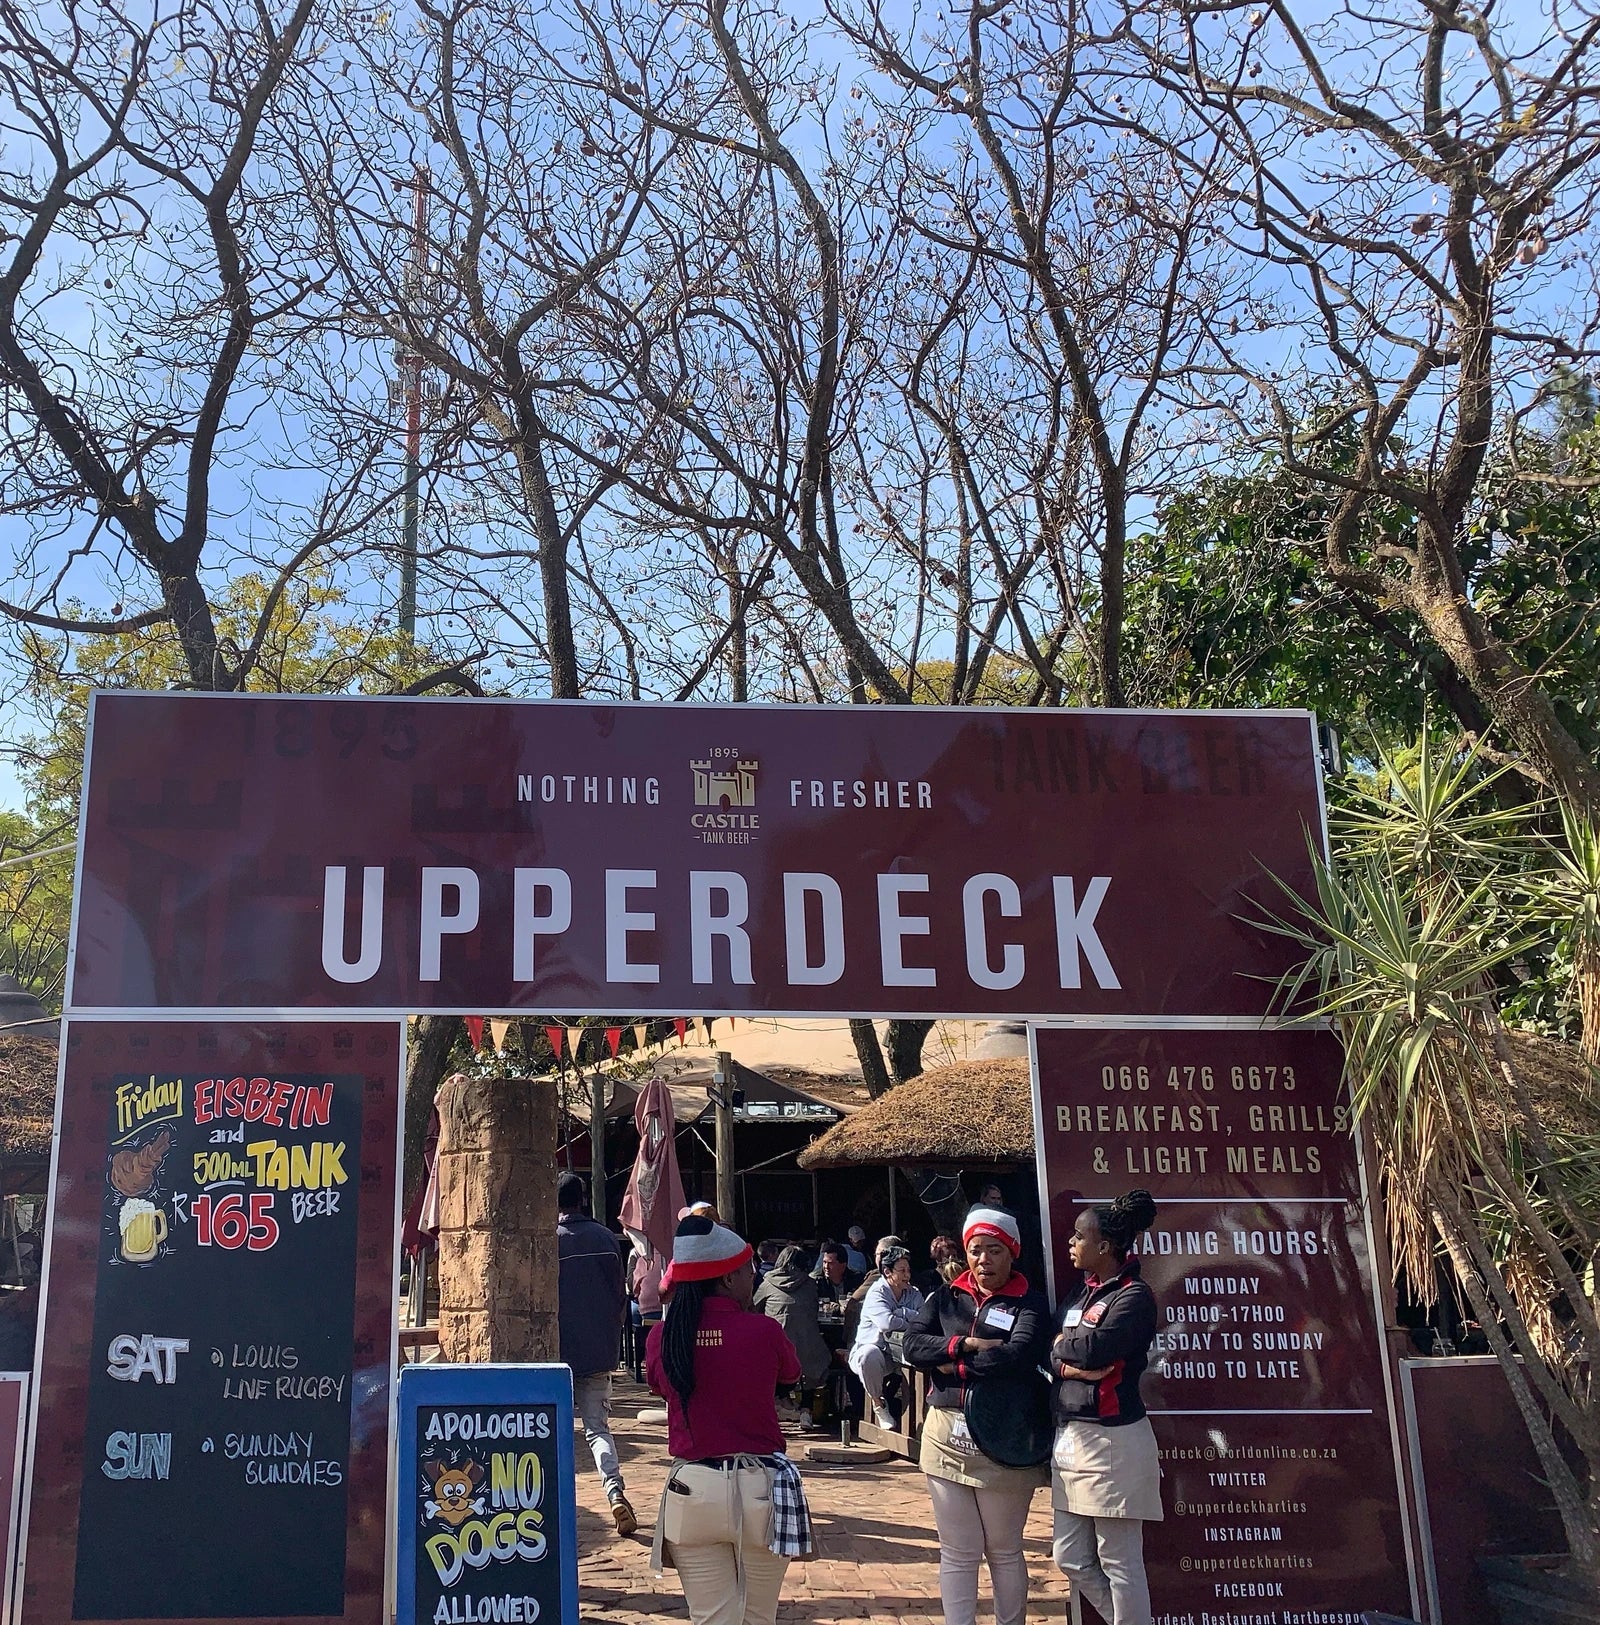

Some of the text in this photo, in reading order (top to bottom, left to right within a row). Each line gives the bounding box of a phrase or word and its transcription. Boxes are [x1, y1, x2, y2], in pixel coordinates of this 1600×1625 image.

[708, 748, 739, 759] 1895
[517, 774, 933, 809] NOTHING FRESHER
[690, 814, 761, 830] CASTLE
[702, 831, 750, 845] TANK BEER
[321, 866, 1123, 991] UPPERDECK
[1101, 1066, 1296, 1091] 066 476 6673
[116, 1074, 183, 1134] Friday
[193, 1076, 335, 1131] EISBEIN
[209, 1121, 245, 1144] and
[1057, 1104, 1349, 1136] BREAKFAST, GRILLS
[193, 1139, 348, 1191] 500ML TANK
[1092, 1146, 1322, 1174] & LIGHT MEALS
[291, 1188, 341, 1225] BEER
[1132, 1230, 1329, 1256] ADING HOURS:
[1185, 1277, 1260, 1295] MONDAY
[1165, 1305, 1285, 1323] 08H00-17H00
[696, 1338, 723, 1346] RESHER
[697, 1329, 722, 1337] OTHING
[1147, 1332, 1324, 1351] ESDAY TO SUNDAY
[106, 1333, 190, 1386] SAT
[231, 1344, 299, 1370] LOUIS
[1163, 1360, 1300, 1380] 08H00 TO LATE
[276, 1374, 347, 1403] RUGBY
[425, 1412, 551, 1441] APOLOGIES
[101, 1430, 173, 1481] SUN
[224, 1431, 314, 1460] SUNDAY
[1157, 1446, 1338, 1461] erdeck@worldonline.co.za
[245, 1461, 344, 1487] SUNDAES
[490, 1452, 546, 1511] NO
[1208, 1472, 1267, 1487] TWITTER
[1174, 1499, 1308, 1516] @upperdeckharties
[1204, 1526, 1282, 1542] INSTAGRAM
[425, 1510, 549, 1588] DOGS
[1179, 1555, 1313, 1573] @upperdeckharties
[1214, 1583, 1284, 1599] FACEBOOK
[433, 1594, 541, 1625] ALLOWED
[1150, 1612, 1195, 1625] erdeck
[1201, 1611, 1278, 1625] Restaurant
